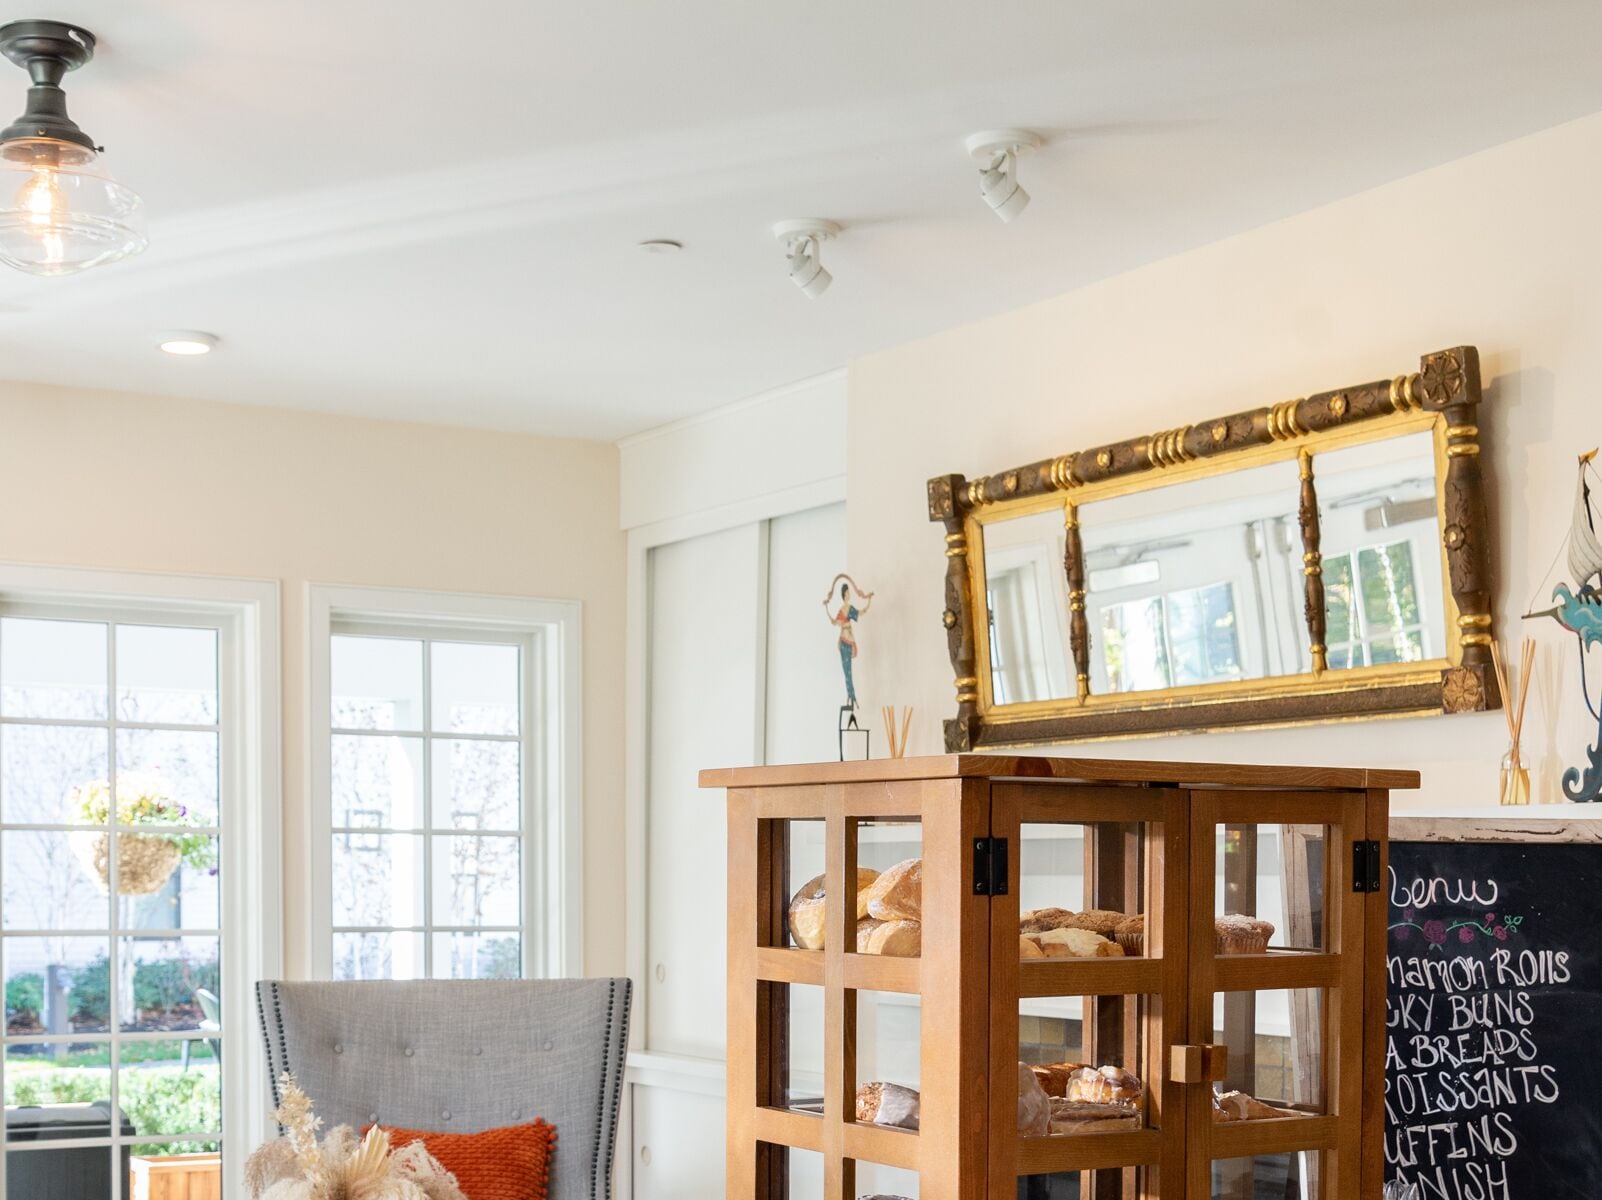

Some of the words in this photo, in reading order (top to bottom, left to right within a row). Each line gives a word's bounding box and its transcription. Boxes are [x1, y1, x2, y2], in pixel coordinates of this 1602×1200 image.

[1448, 990, 1534, 1031] BUNS
[1409, 1028, 1537, 1069] BREADS
[1384, 1112, 1517, 1167] UFFINS
